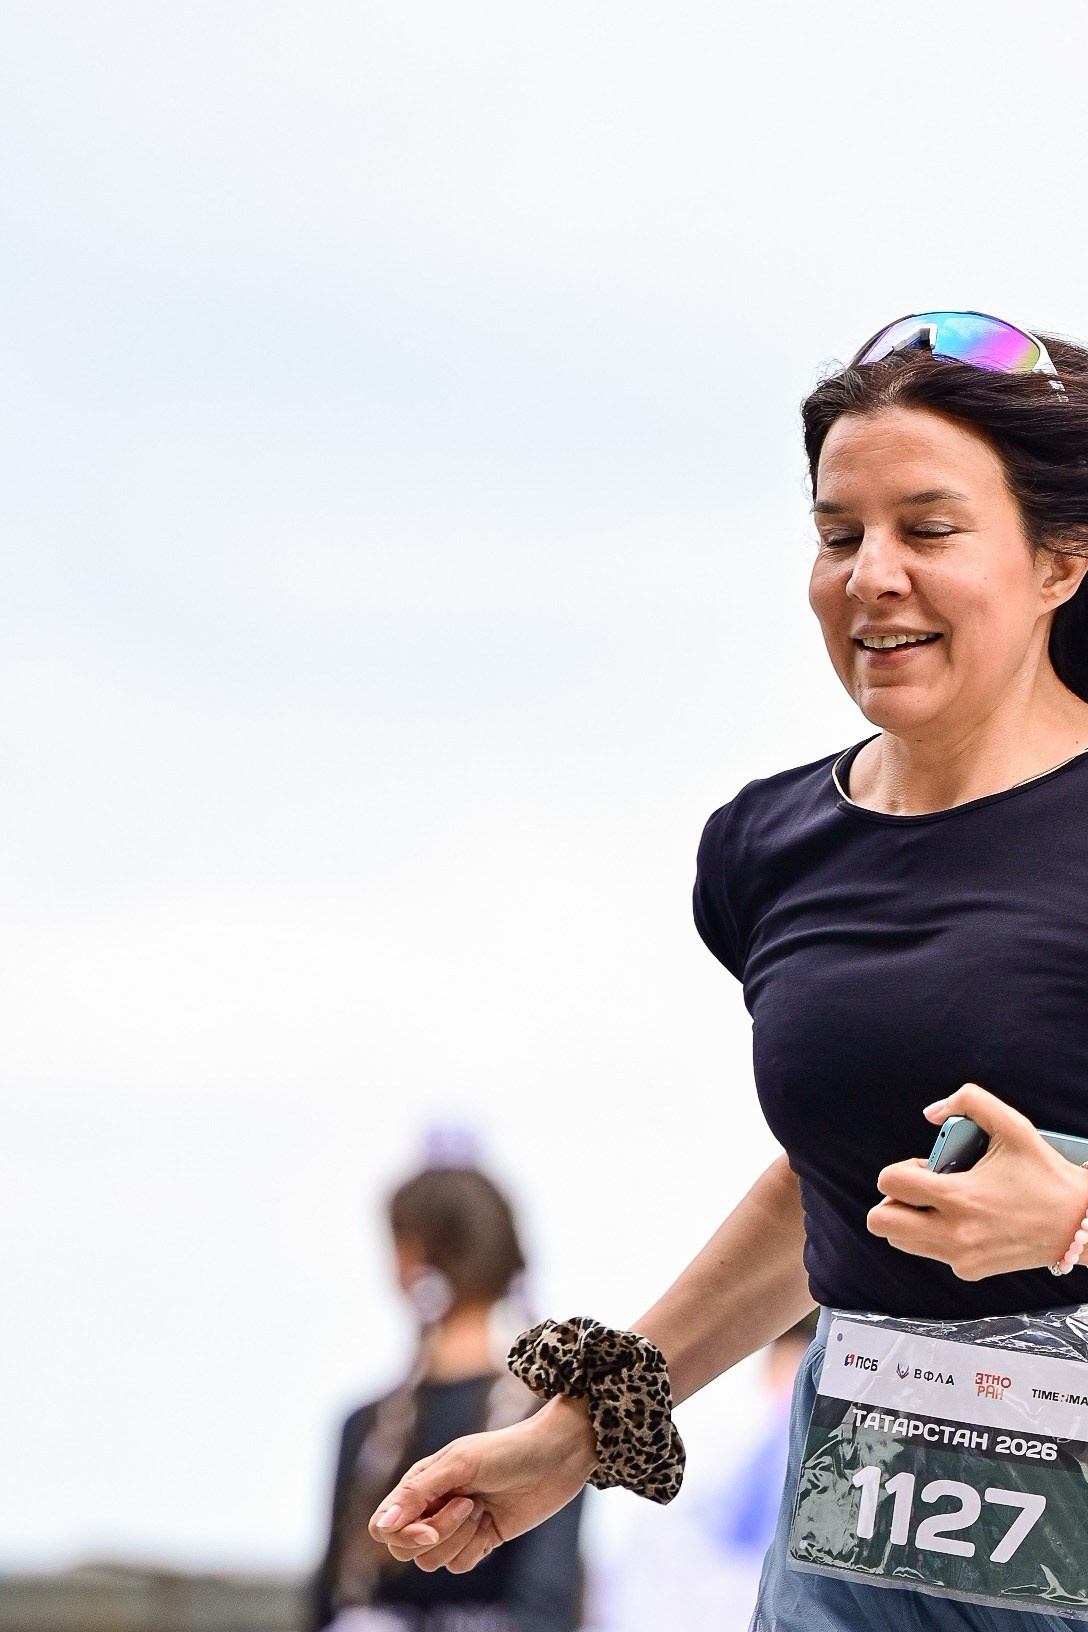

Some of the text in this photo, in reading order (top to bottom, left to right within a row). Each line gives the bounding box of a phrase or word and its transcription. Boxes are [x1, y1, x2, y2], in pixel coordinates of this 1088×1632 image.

[855, 1355, 879, 1372] ПСБ
[913, 1368, 955, 1386] ВФЛА
[975, 1372, 1012, 1389] ЭТНО
[852, 1408, 1059, 1461] ТАТАРСТАН 2026
[852, 1465, 1047, 1564] 1127
